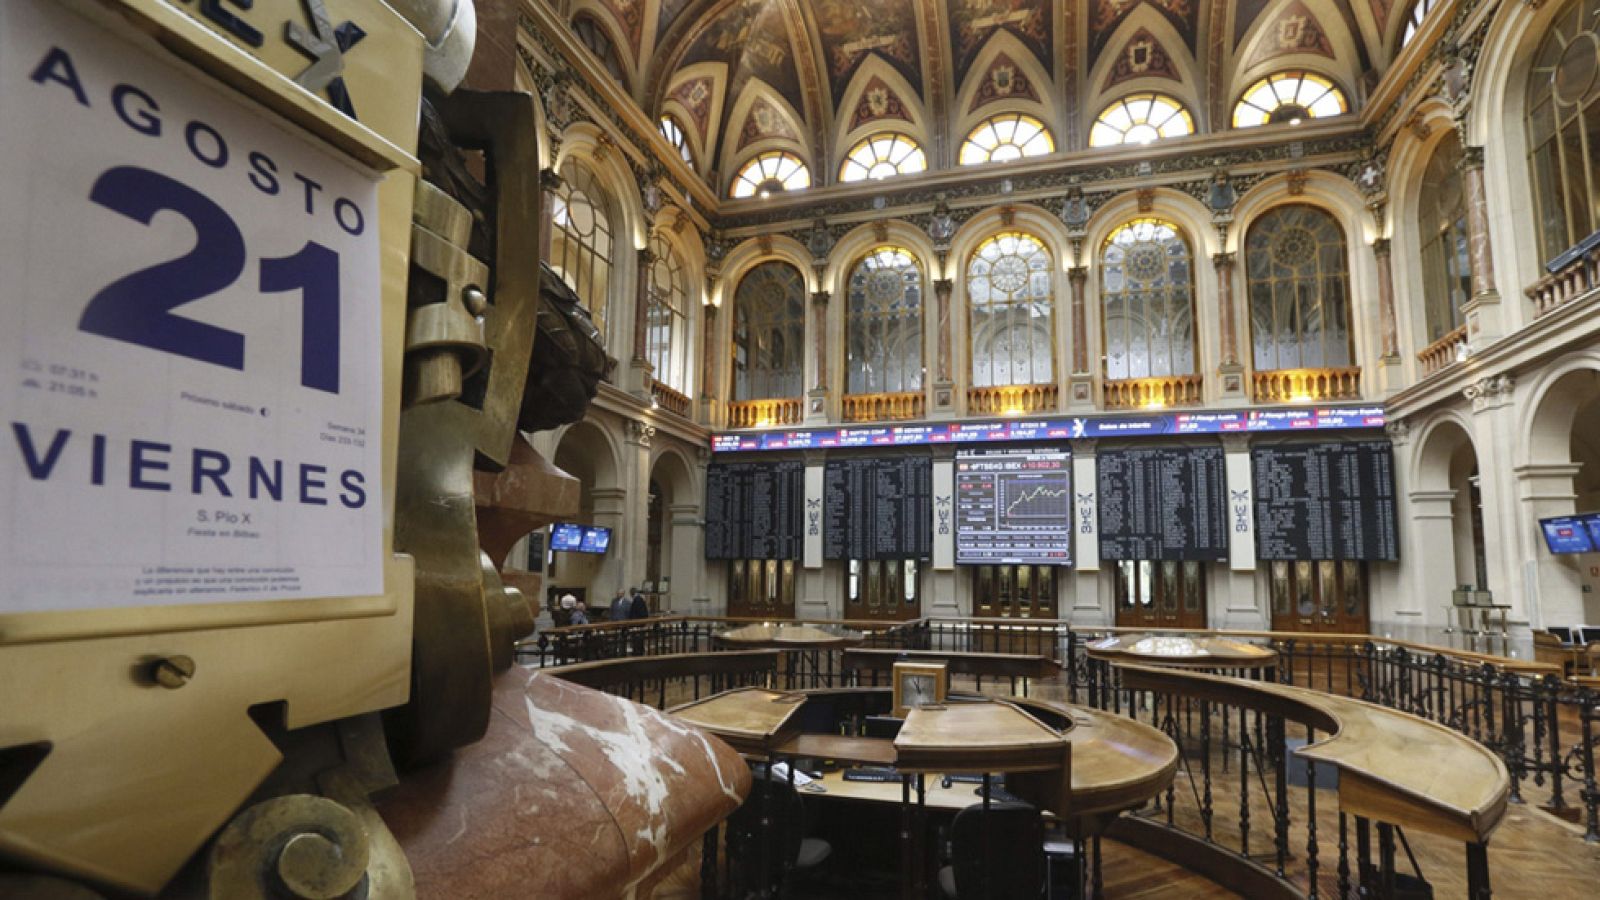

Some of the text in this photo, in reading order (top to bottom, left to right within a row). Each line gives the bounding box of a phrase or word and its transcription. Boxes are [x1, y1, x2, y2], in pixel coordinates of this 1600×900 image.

[31, 46, 365, 237] AGOSTO
[78, 164, 341, 395] 21
[12, 422, 367, 509] VIERNES
[241, 511, 251, 524] X
